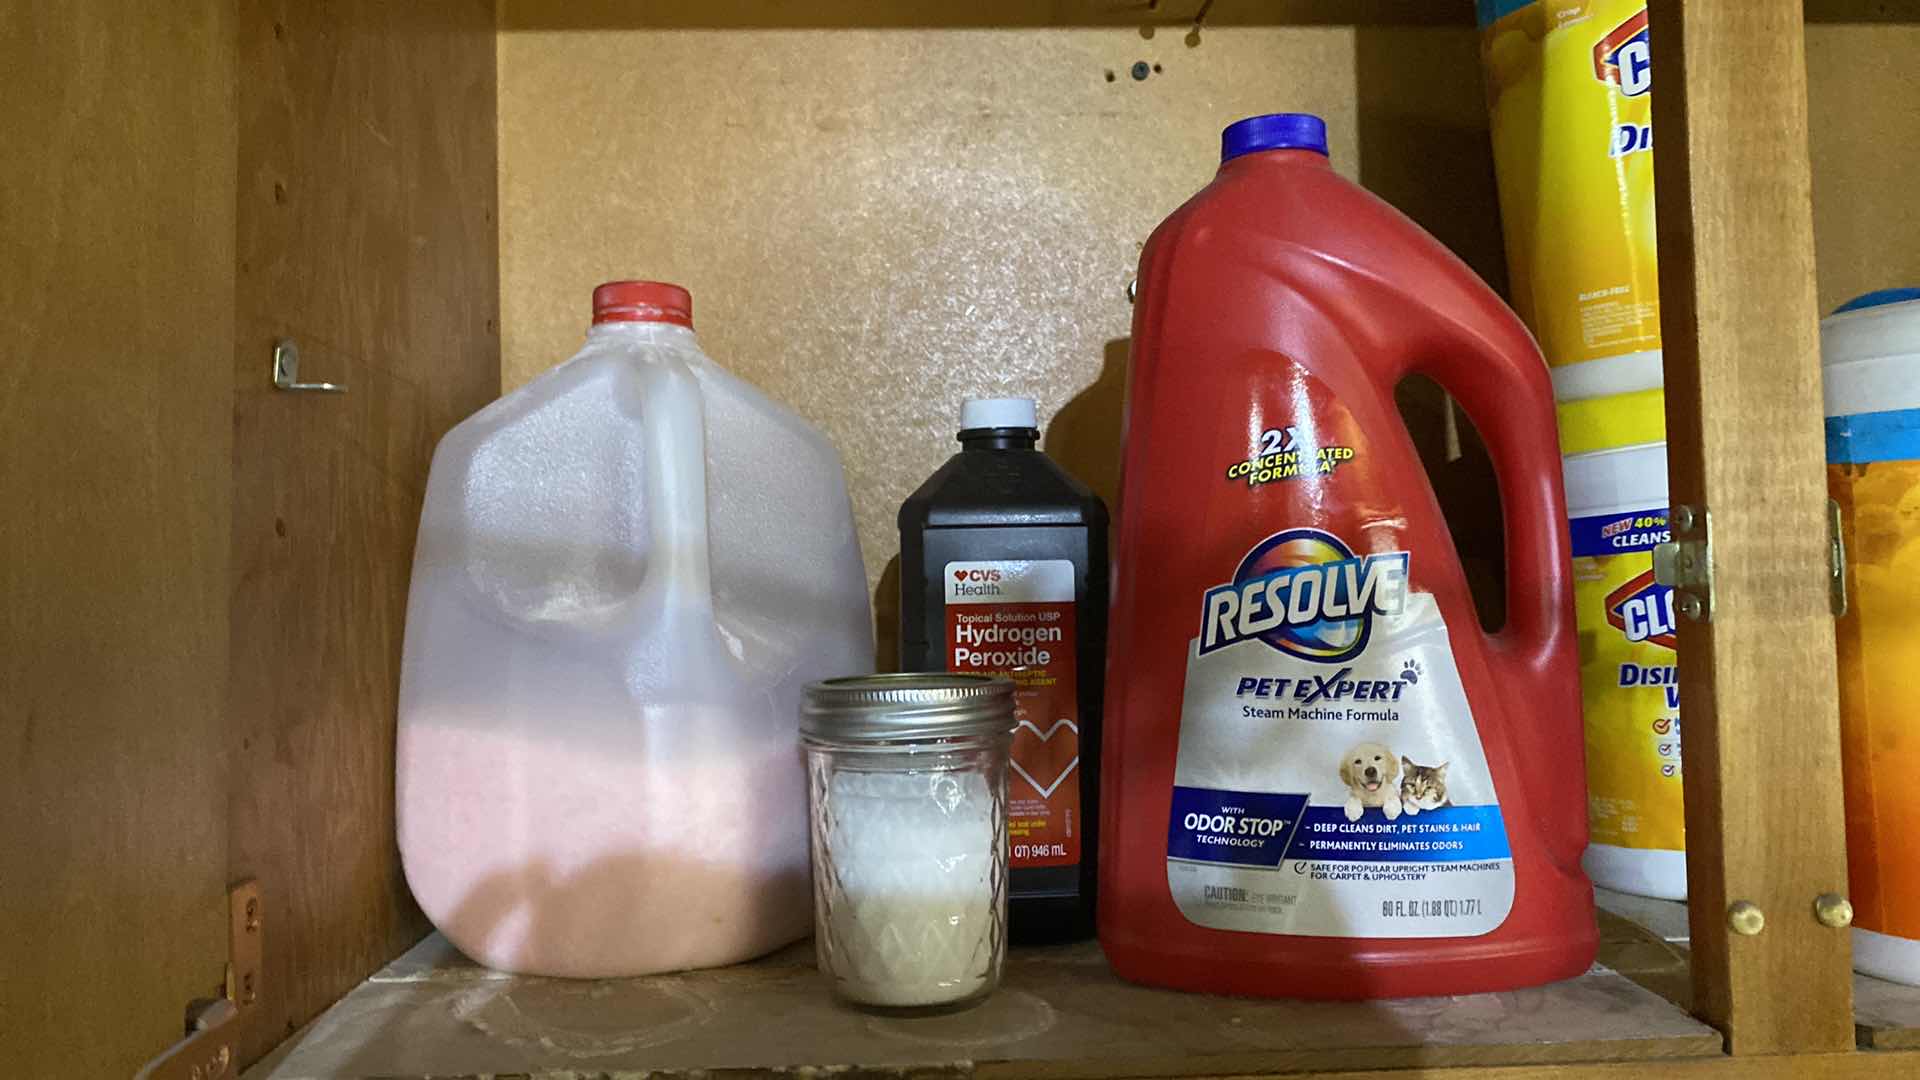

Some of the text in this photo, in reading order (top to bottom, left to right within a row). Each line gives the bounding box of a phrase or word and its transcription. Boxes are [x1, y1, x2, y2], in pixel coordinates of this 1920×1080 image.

[1602, 517, 1665, 538] NEW 40%
[1612, 531, 1671, 548] CLEANS
[969, 569, 1001, 582] CVS
[954, 583, 1000, 596] Health
[1201, 552, 1410, 653] RESOLVE
[956, 612, 1060, 624] Topical Solution USP
[955, 624, 1061, 647] Hydrogen
[954, 646, 1050, 667] Peroxide
[1236, 668, 1407, 704] PET EXPERT
[1242, 706, 1399, 721] Steam Machine Formula
[1221, 806, 1245, 815] WITH
[1184, 813, 1235, 834] ODOR
[1313, 822, 1481, 835] DEEP CLEANS DIRT, PET STAINS & HAIR
[1196, 835, 1265, 848] TECHNOLOGY
[1309, 840, 1463, 851] PERMANENTLY ELIMINATES ODORS
[1031, 844, 1050, 857] 946
[1051, 843, 1067, 856] mL
[1310, 862, 1500, 873] SAFE FOR POPULAR UPRIGHT STEAM MACHINES
[1310, 872, 1426, 881] FOR CARPET & UPHOLSTERY
[1459, 898, 1475, 915] 1.77
[1477, 899, 1482, 914] L
